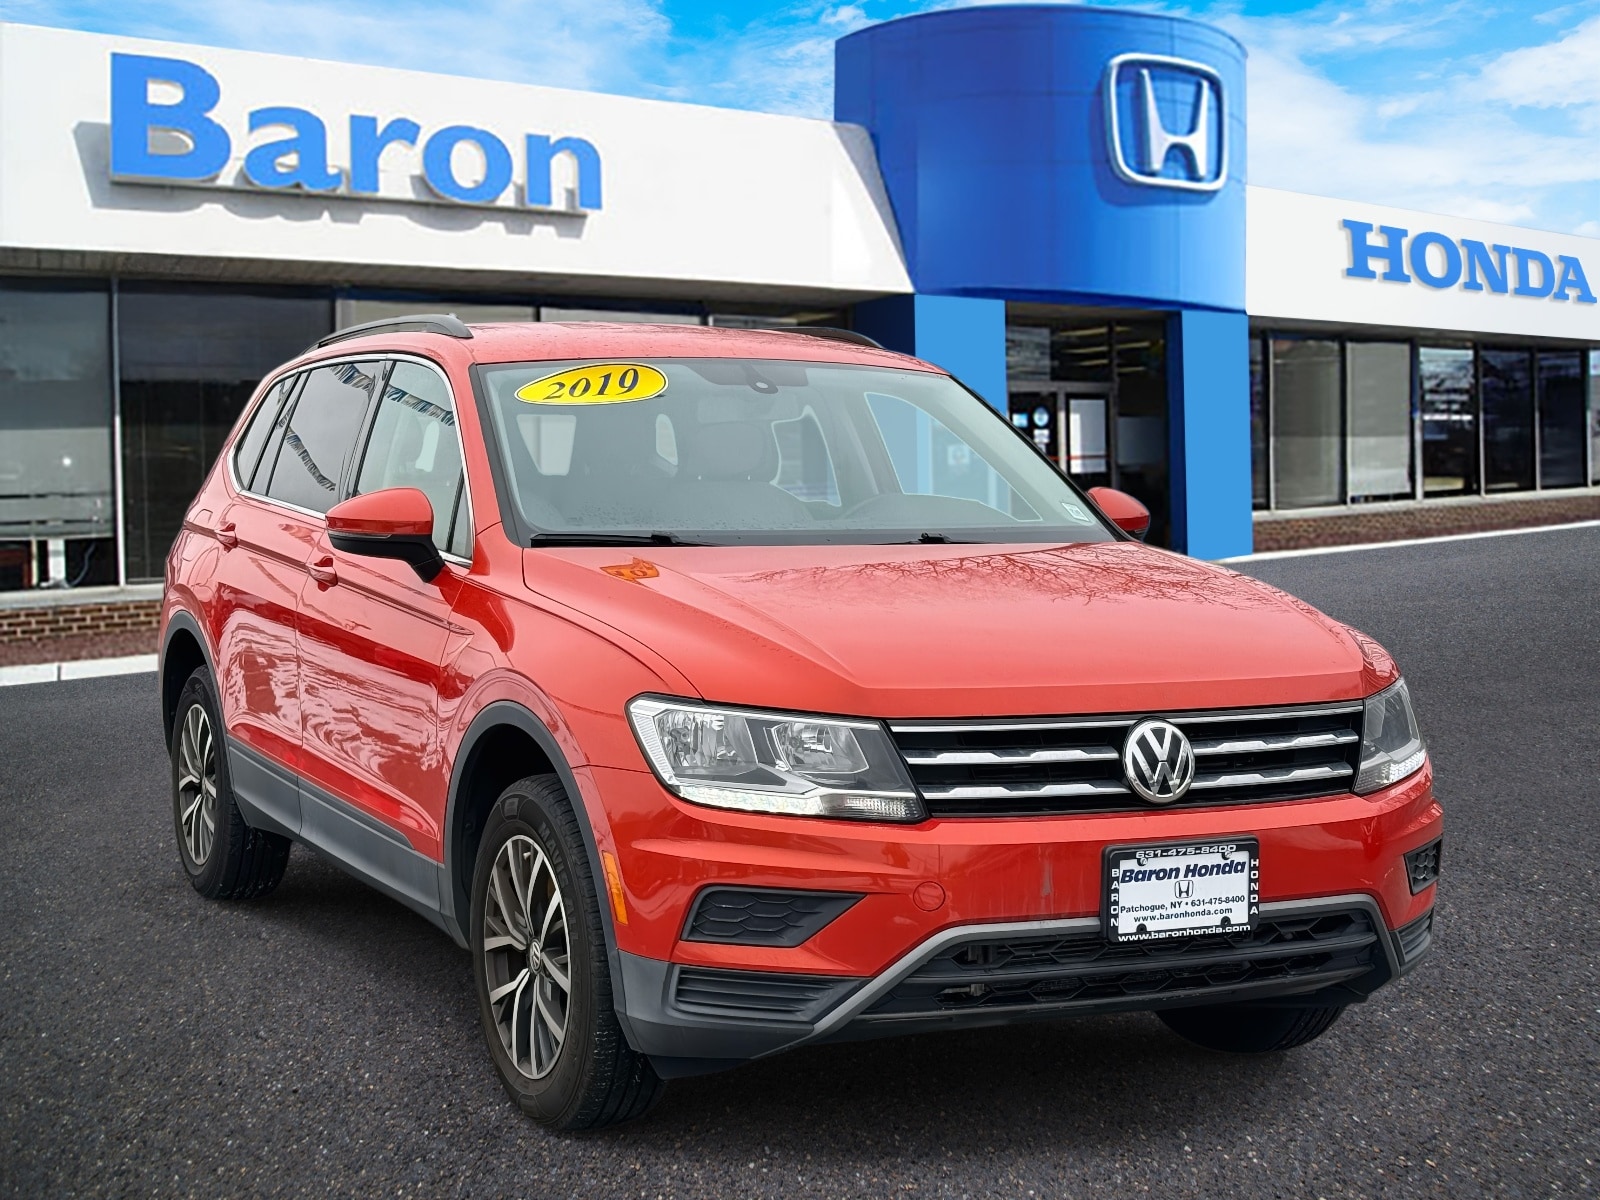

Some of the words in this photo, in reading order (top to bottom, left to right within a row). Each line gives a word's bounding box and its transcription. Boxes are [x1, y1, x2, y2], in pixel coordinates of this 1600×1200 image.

[110, 51, 603, 211] Baron
[1342, 219, 1597, 303] HONDA
[543, 367, 639, 400] 2019
[1135, 844, 1236, 859] 631-475-8400
[1120, 868, 1180, 884] Baron
[1184, 859, 1247, 879] Honda
[1110, 868, 1120, 928] BARON
[1250, 858, 1259, 915] HONDA
[1120, 903, 1168, 914] Patchogue,
[1170, 901, 1183, 909] NY
[1190, 895, 1245, 908] 631-475-8400
[1133, 907, 1233, 923] www.baronhonda.com
[1118, 924, 1251, 942] www.baronhonda.com
